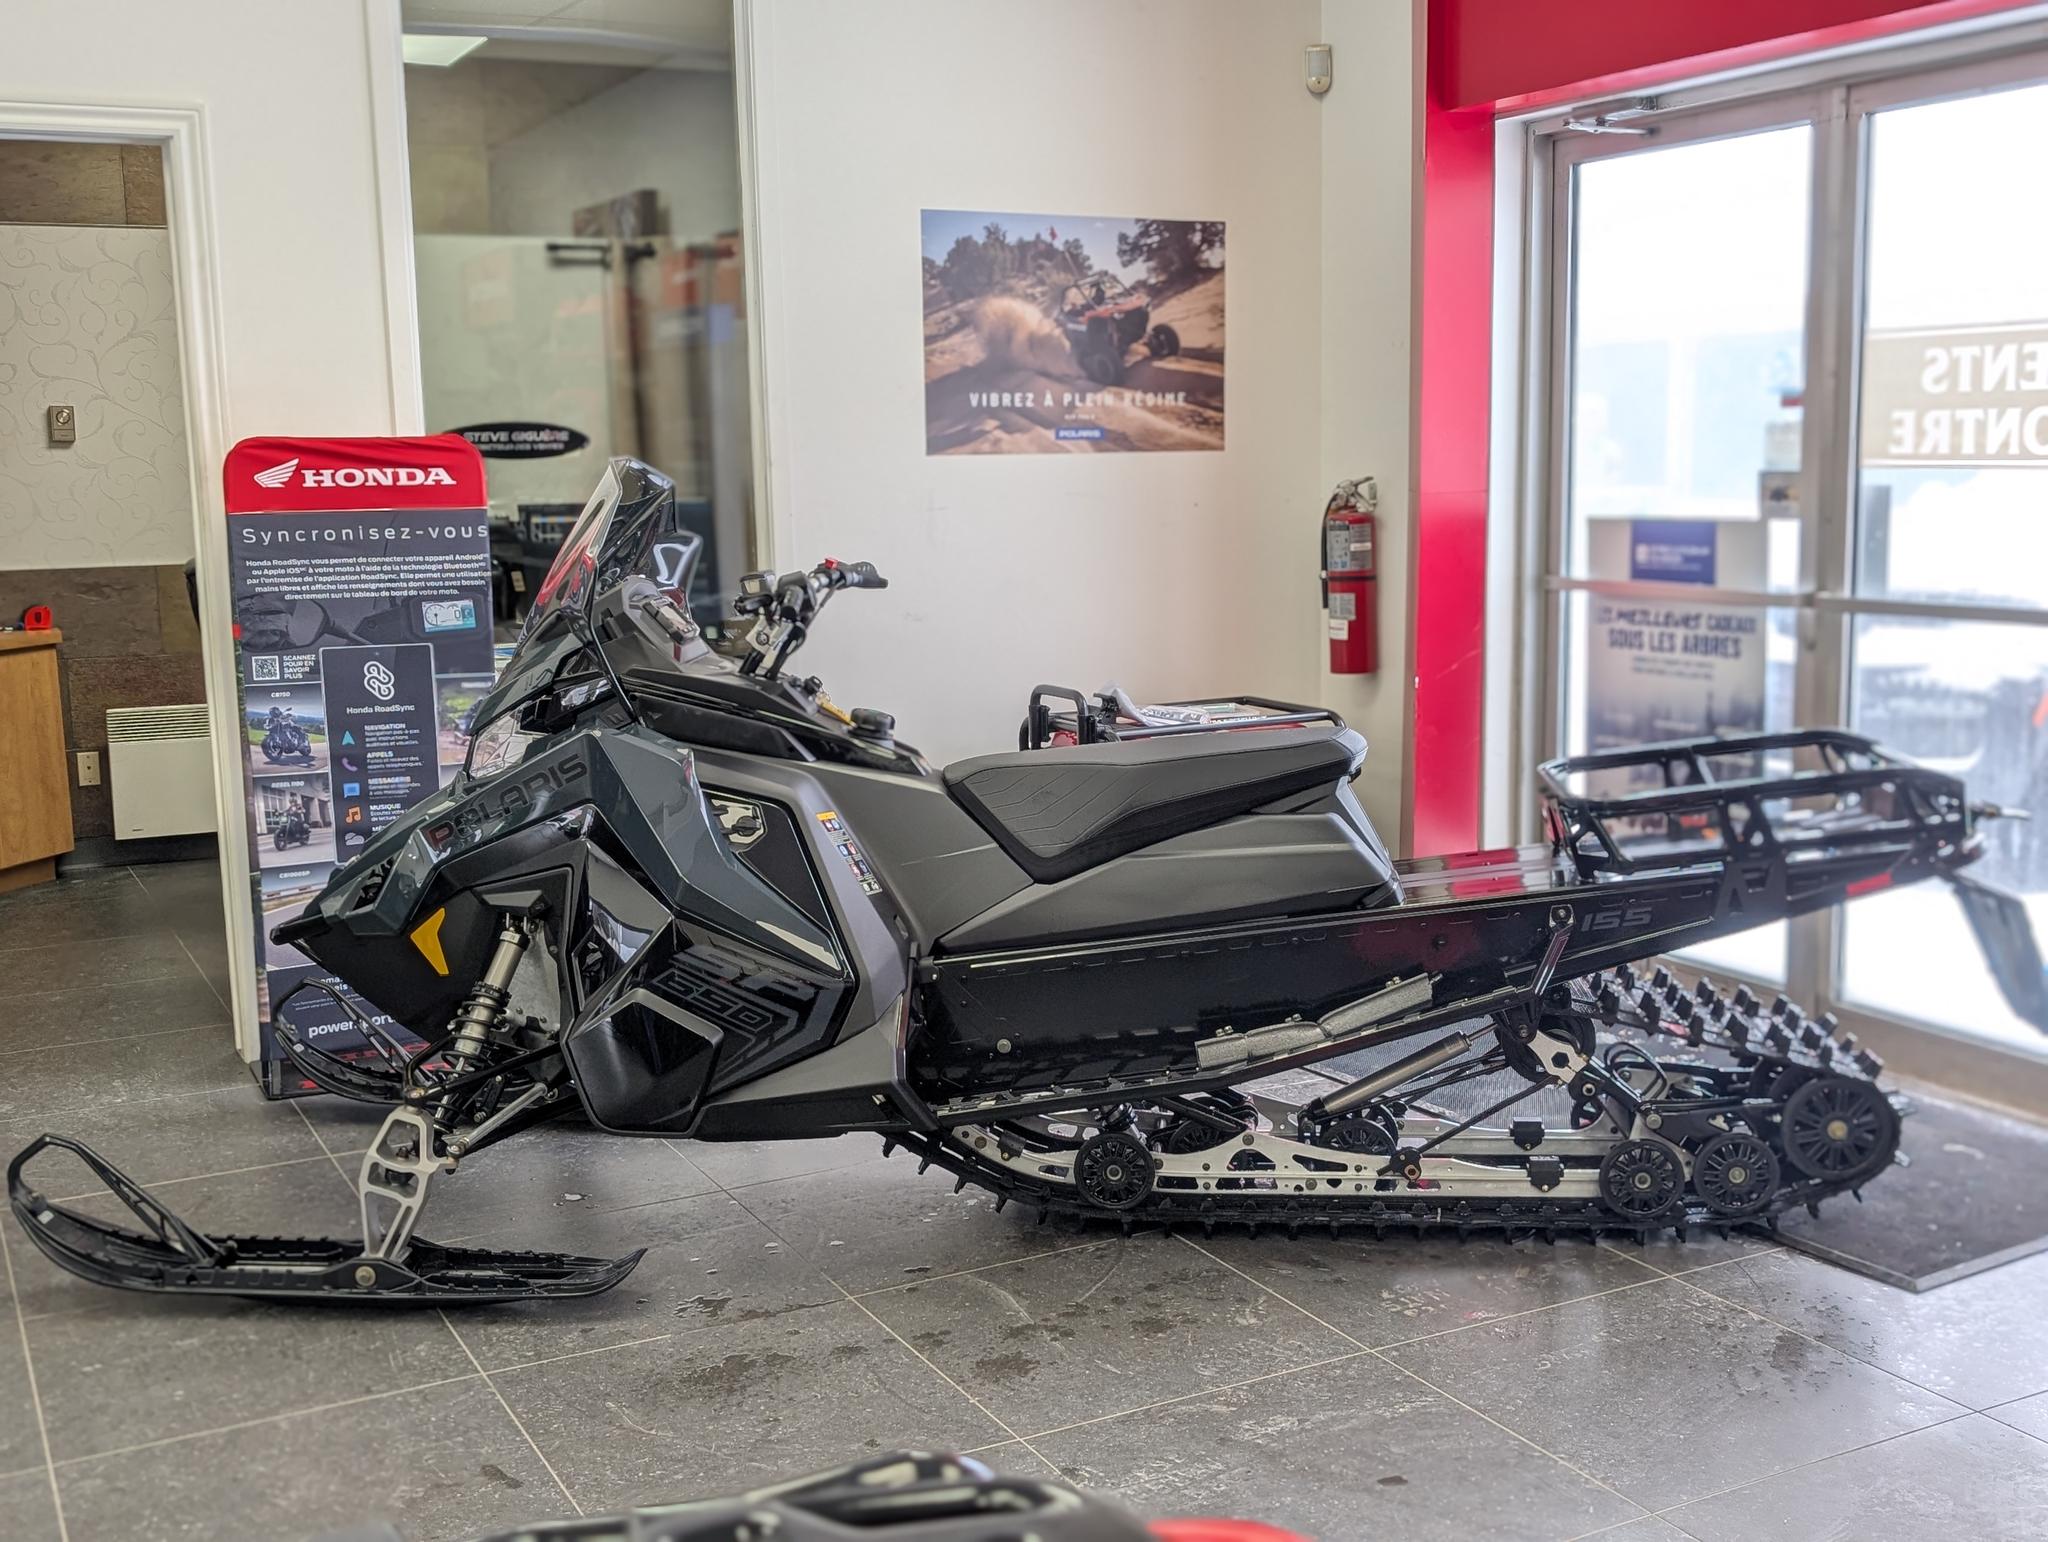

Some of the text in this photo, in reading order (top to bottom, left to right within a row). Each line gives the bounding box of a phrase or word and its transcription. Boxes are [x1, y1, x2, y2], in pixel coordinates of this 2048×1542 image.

[968, 391, 1035, 408] VIBREZ
[1043, 389, 1054, 407] À
[1062, 391, 1115, 407] PLEIN
[301, 467, 457, 488] HONDA
[242, 525, 488, 546] Syncronisez-vous
[272, 558, 310, 567] RoadSync
[329, 556, 357, 565] permet
[367, 555, 404, 563] connecter
[424, 554, 454, 562] appareil
[263, 568, 286, 576] Apple
[400, 563, 443, 571] technologie
[414, 572, 441, 580] permet
[310, 583, 337, 591] affiche
[349, 581, 408, 590] renseignements
[408, 580, 426, 588] dont
[351, 590, 380, 598] tableau
[1609, 628, 1742, 659] SOUS LES ARBRES
[284, 672, 304, 680] PLUS
[346, 704, 416, 715] Honda RoadSync
[364, 723, 407, 731] NAVIGATION
[366, 750, 394, 759] APPELS
[425, 753, 588, 851] POLARIS
[1580, 907, 1653, 933] 155
[651, 967, 774, 1033] 650
